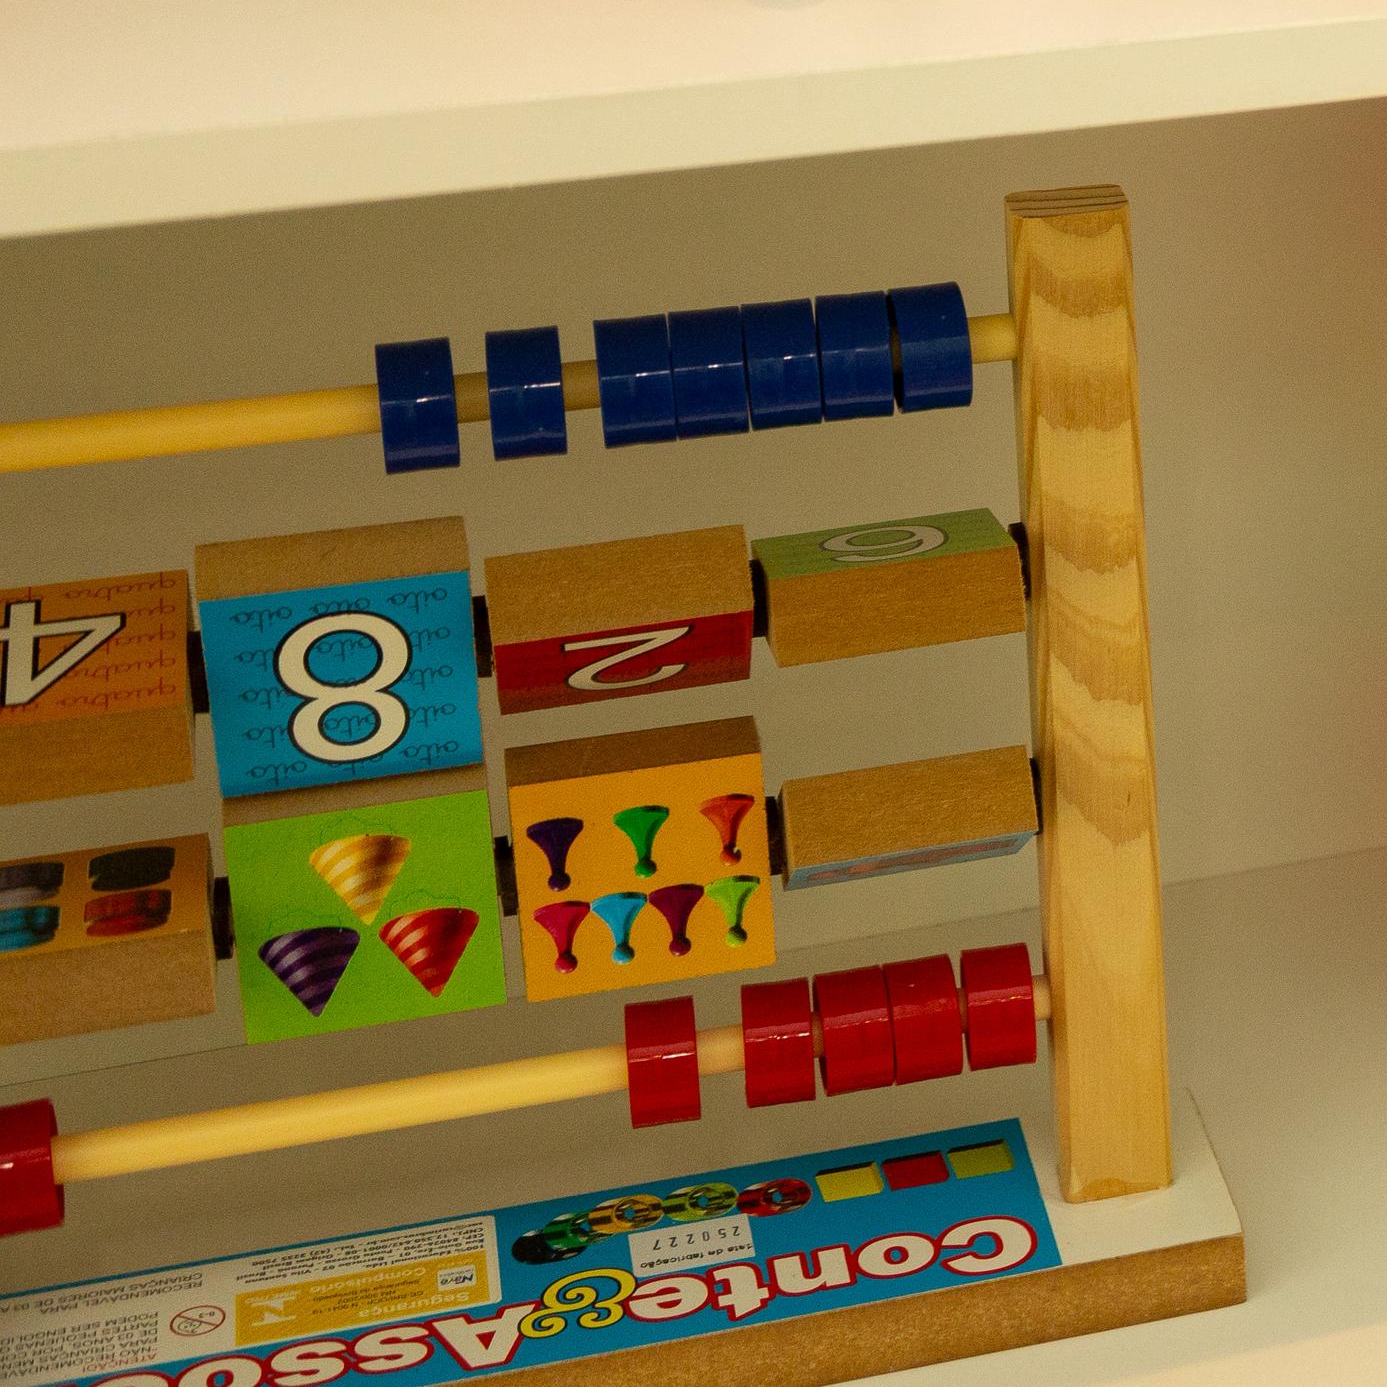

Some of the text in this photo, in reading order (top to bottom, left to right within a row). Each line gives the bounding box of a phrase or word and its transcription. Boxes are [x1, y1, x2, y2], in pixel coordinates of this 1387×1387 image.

[560, 624, 692, 692] 2
[272, 610, 413, 764] 8
[626, 1216, 1036, 1321] Conte
[81, 1280, 203, 1308] RECOMENDÁVEL
[356, 1290, 470, 1319] Segurança
[82, 1353, 157, 1372] ATENÇÃO!
